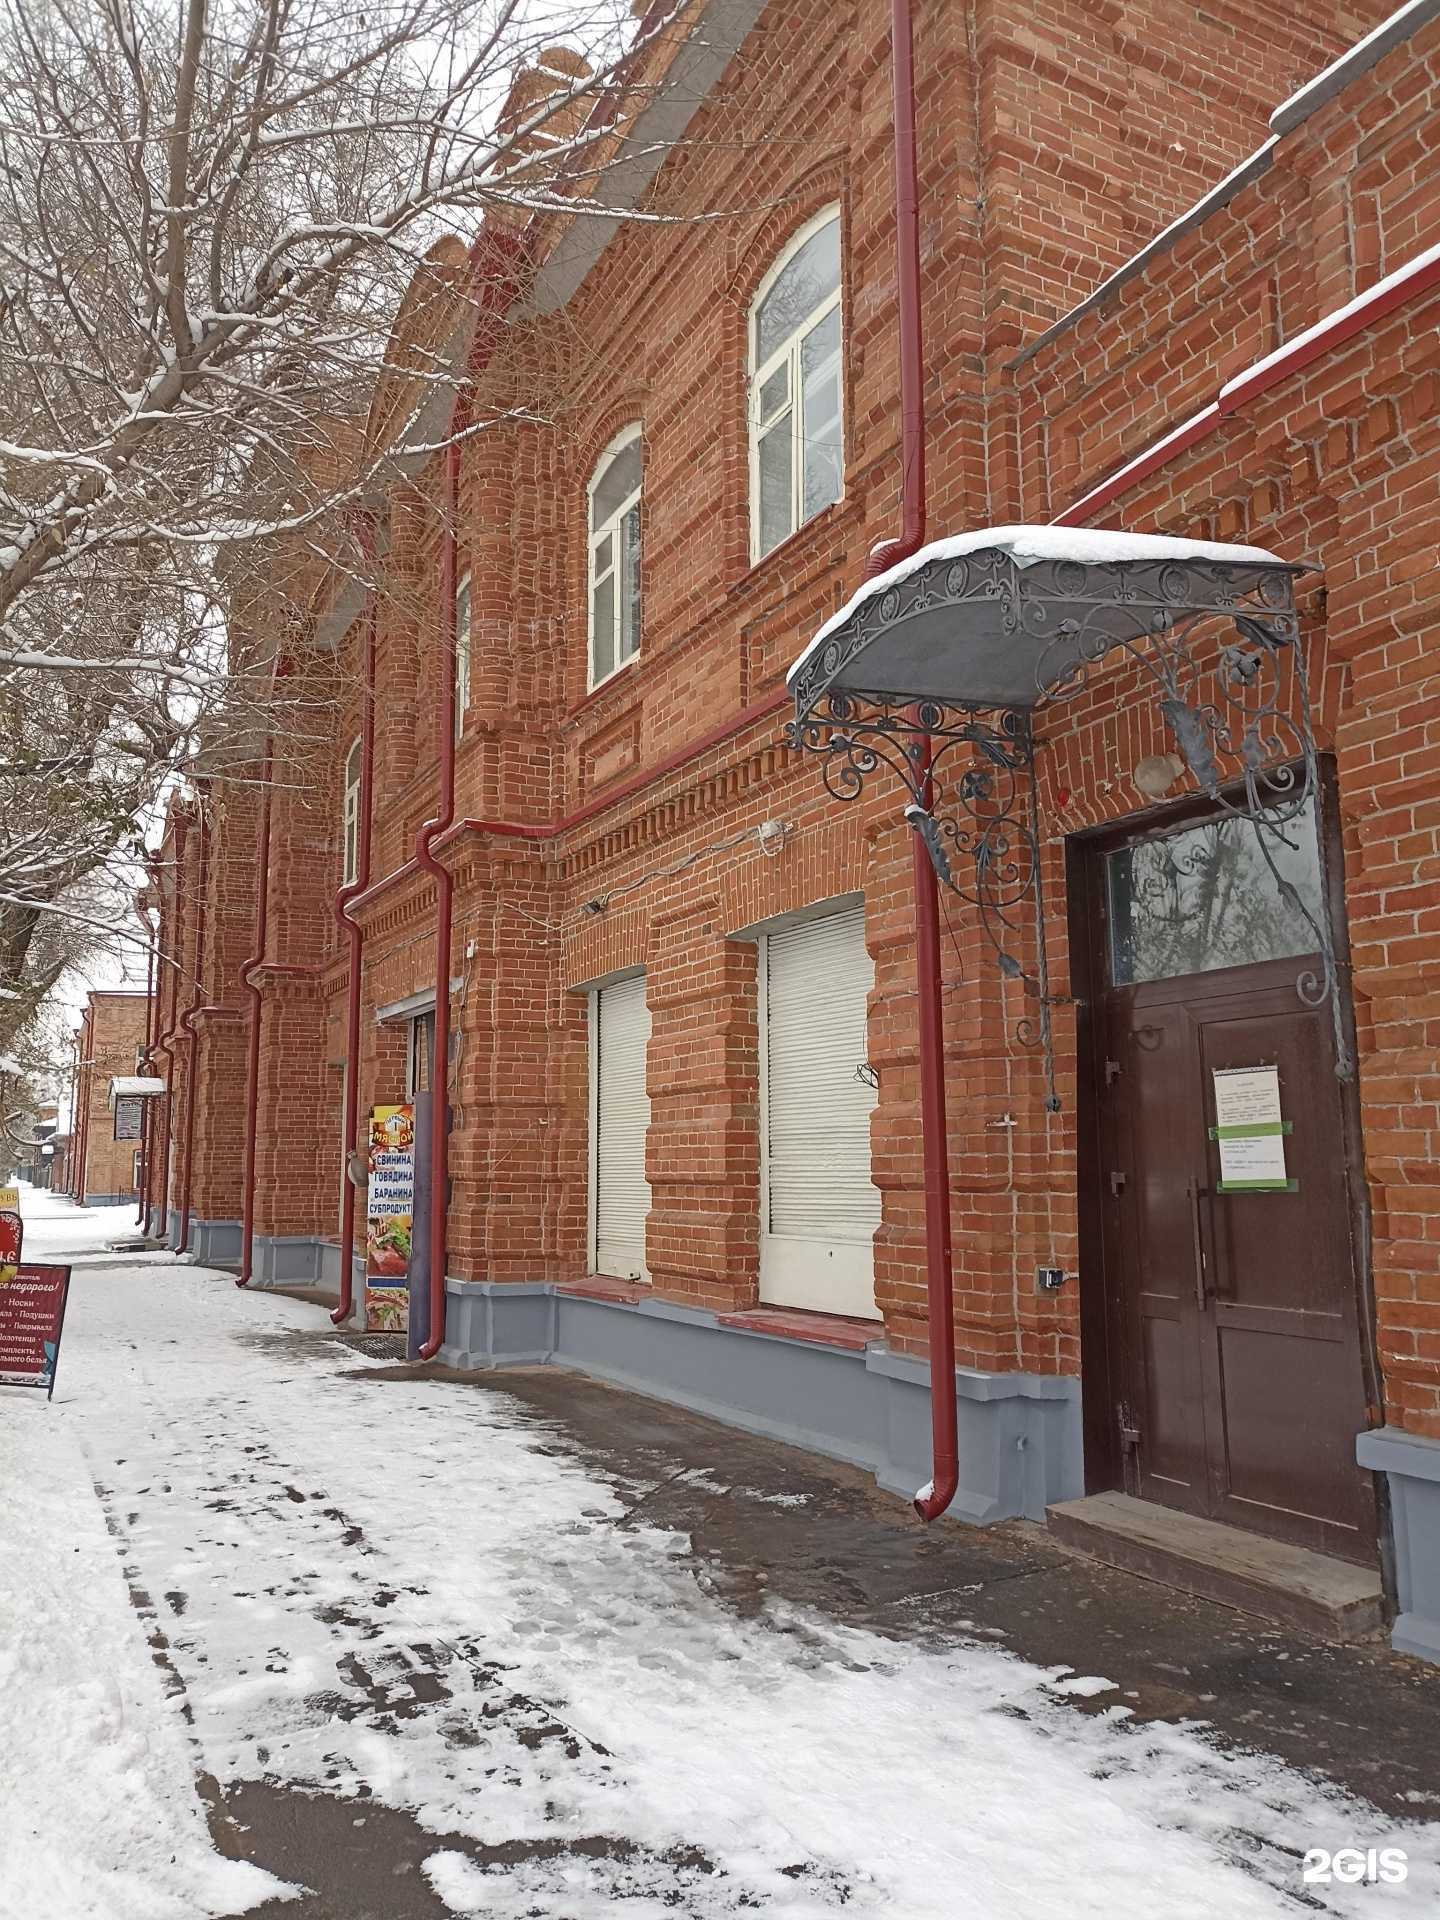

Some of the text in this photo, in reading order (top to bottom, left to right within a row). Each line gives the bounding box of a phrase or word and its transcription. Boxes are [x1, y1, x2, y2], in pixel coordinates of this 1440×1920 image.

[374, 1171, 413, 1183] ГОВЯДИНА
[374, 1187, 413, 1199] БАРАНИНА
[8, 1298, 34, 1307] Носки
[20, 1310, 55, 1320] Подушки
